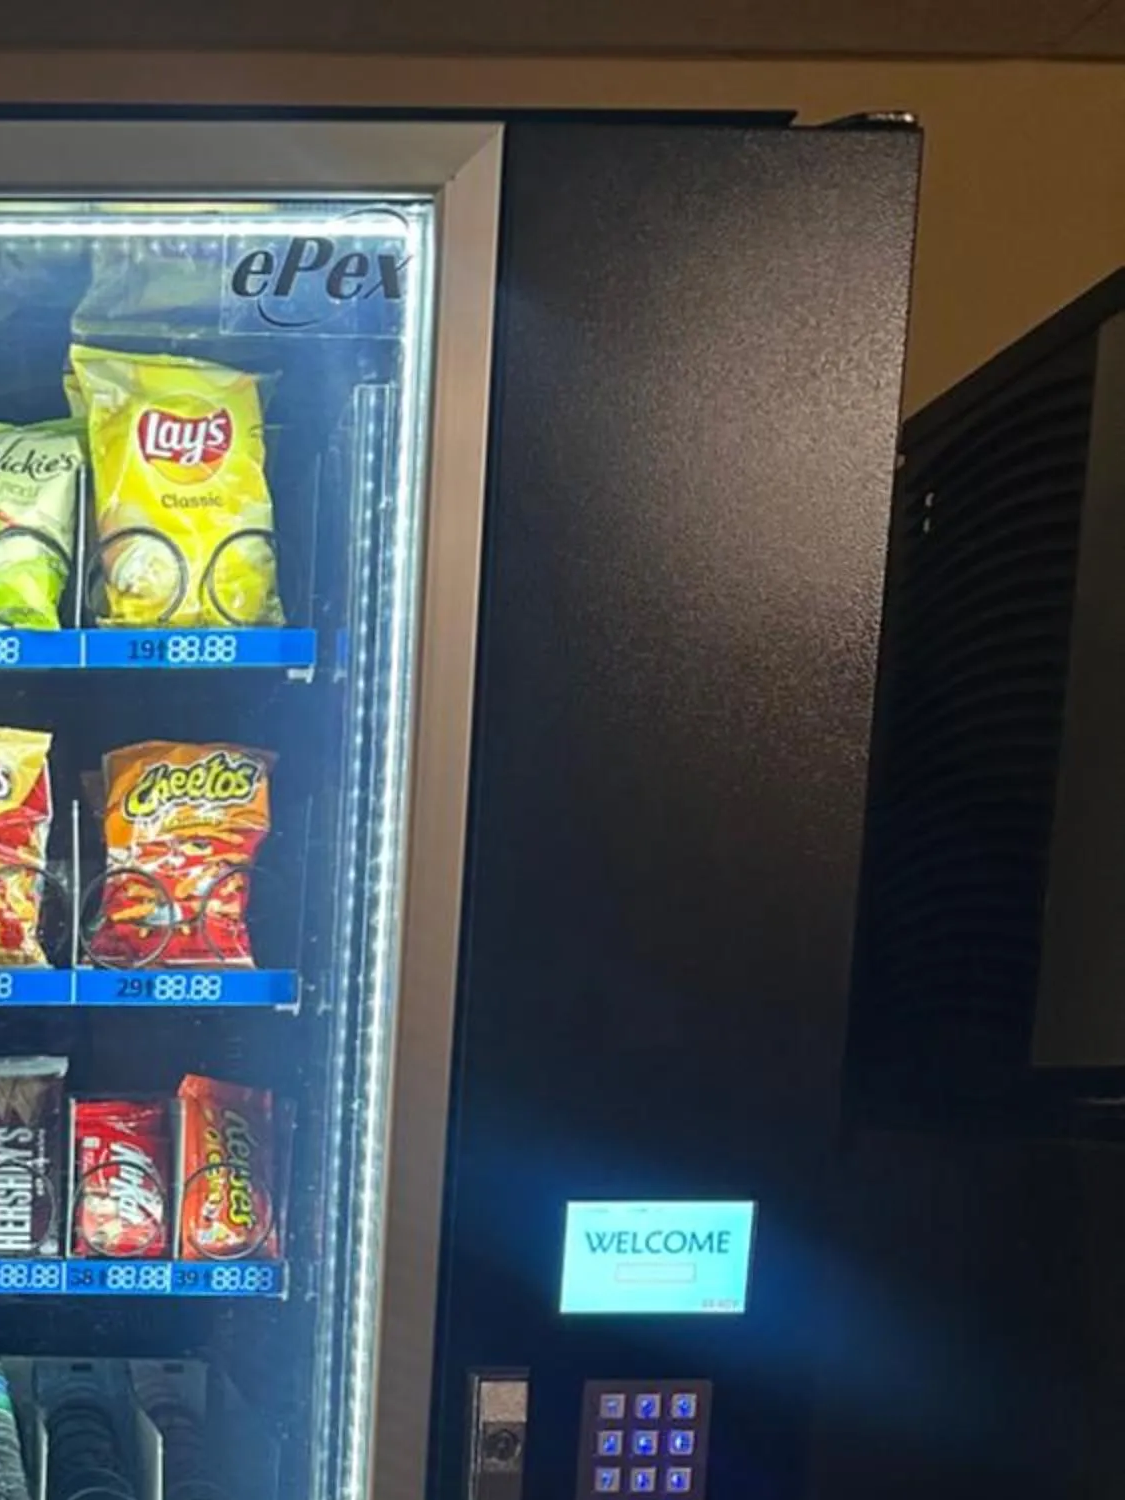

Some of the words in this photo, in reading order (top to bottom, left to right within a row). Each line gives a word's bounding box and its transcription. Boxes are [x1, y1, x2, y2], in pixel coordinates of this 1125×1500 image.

[232, 236, 414, 300] ePex
[144, 411, 227, 465] Lay's
[161, 493, 224, 509] Classic
[129, 640, 157, 660] 19
[167, 636, 237, 662] 88.88
[124, 753, 256, 818] Cheetos
[117, 978, 143, 997] 29
[154, 974, 223, 1000] 88.88
[584, 1230, 732, 1254] WELCOME
